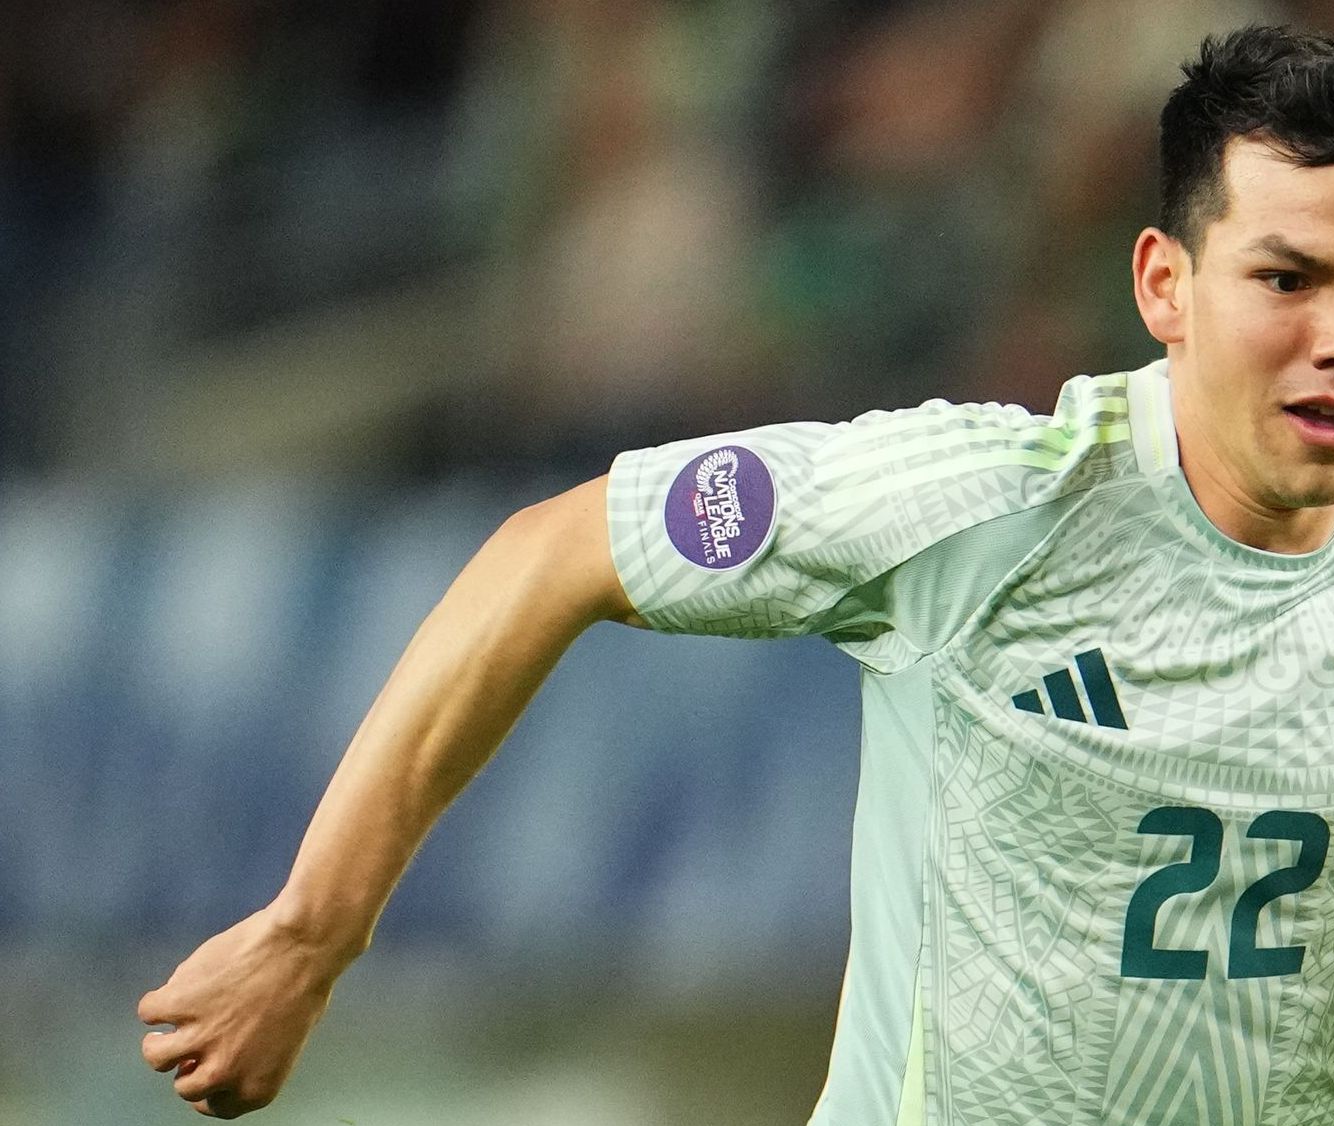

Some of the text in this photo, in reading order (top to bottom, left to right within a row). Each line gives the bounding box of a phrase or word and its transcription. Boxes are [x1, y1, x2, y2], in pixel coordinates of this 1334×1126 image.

[704, 496, 732, 559] LEAGUE
[713, 469, 741, 538] NATIONS
[729, 478, 746, 522] Concacaf
[697, 520, 716, 565] FINALS
[1120, 806, 1331, 980] 22
